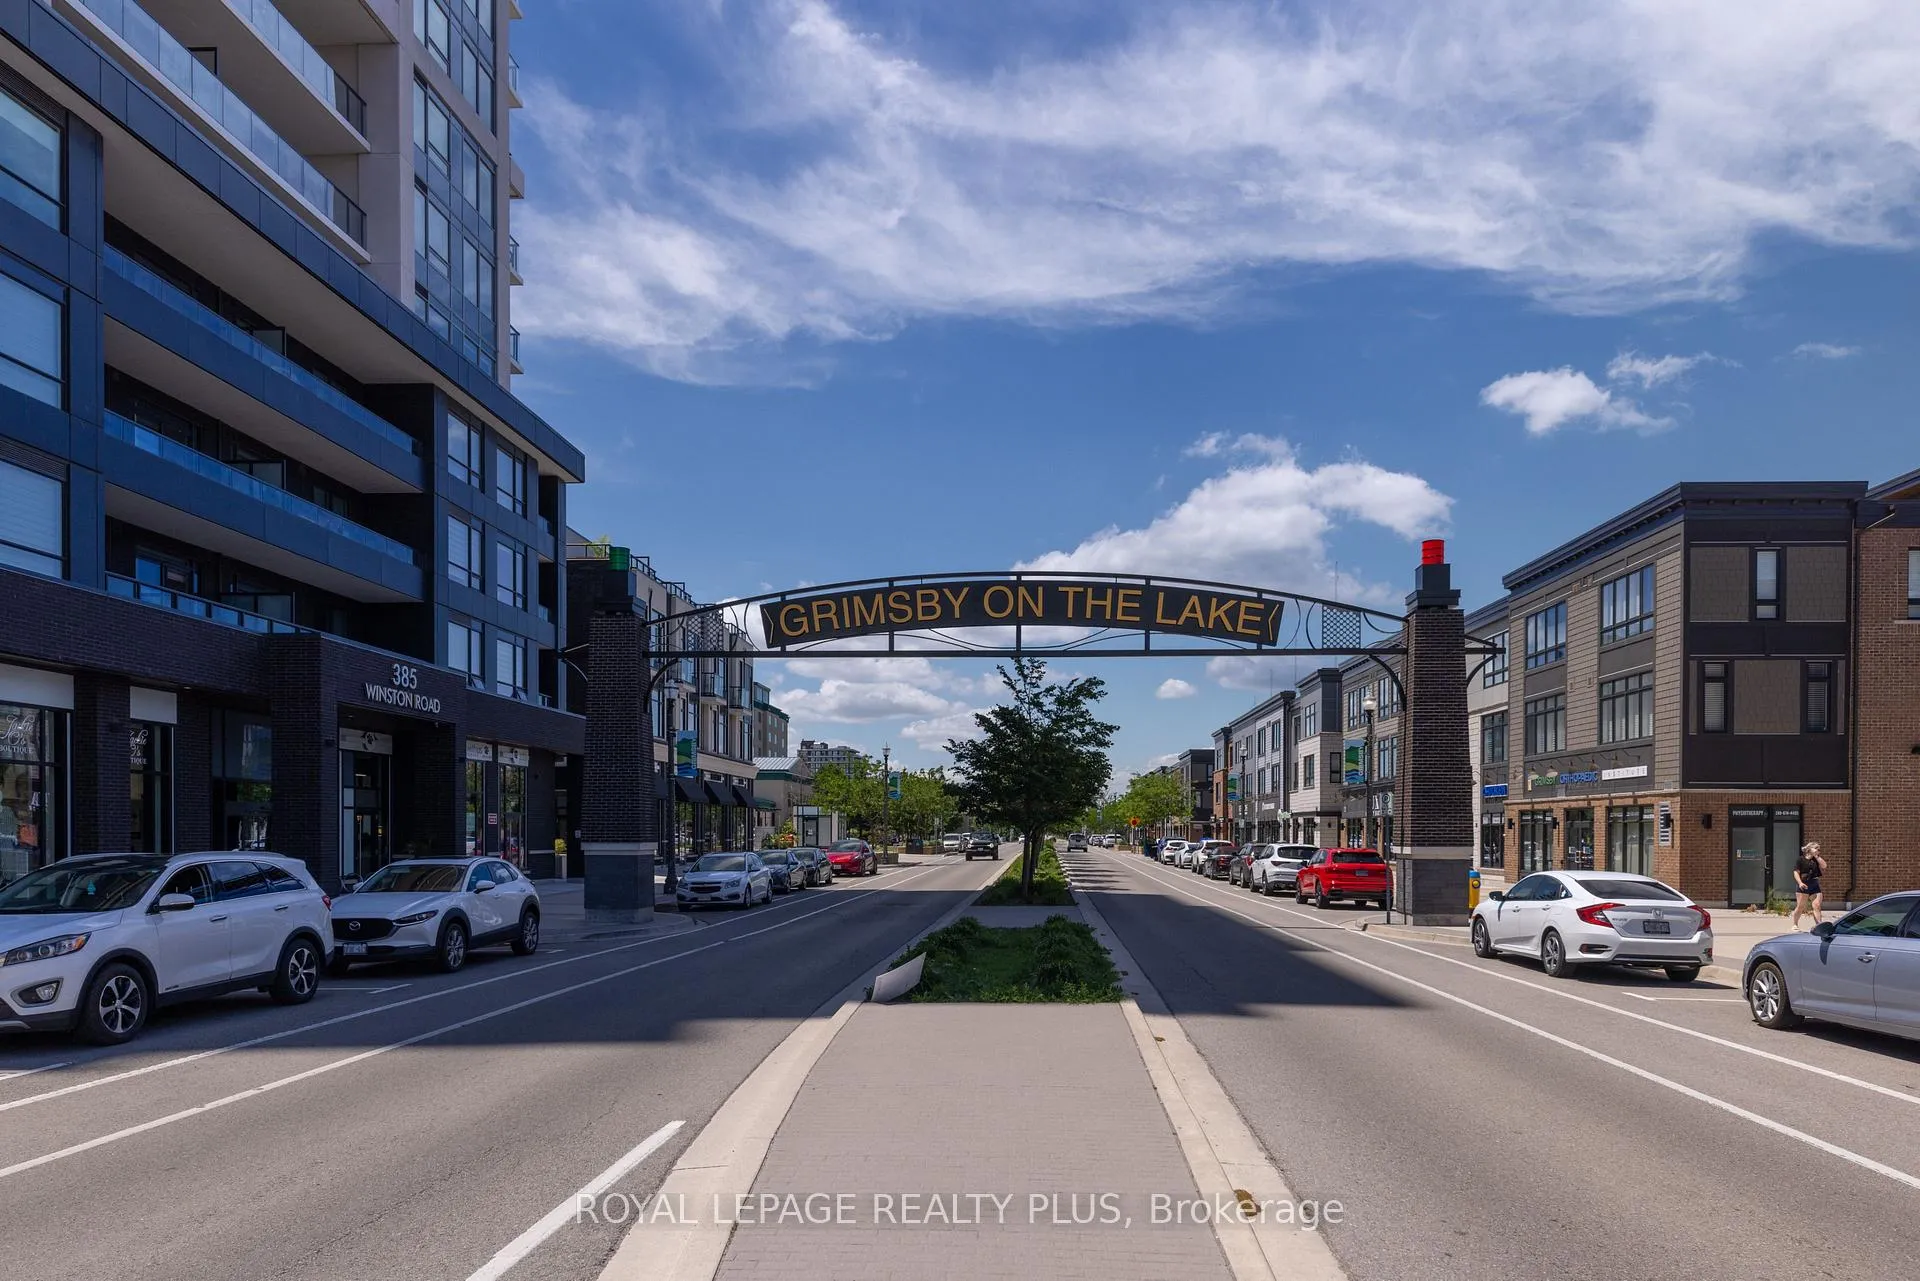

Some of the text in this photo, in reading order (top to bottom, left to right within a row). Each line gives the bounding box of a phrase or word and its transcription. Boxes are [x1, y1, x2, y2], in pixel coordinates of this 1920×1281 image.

[779, 585, 1265, 637] GRIMSBY ON THE LAKE
[392, 663, 417, 690] 385
[365, 682, 441, 714] WINSTON ROAD
